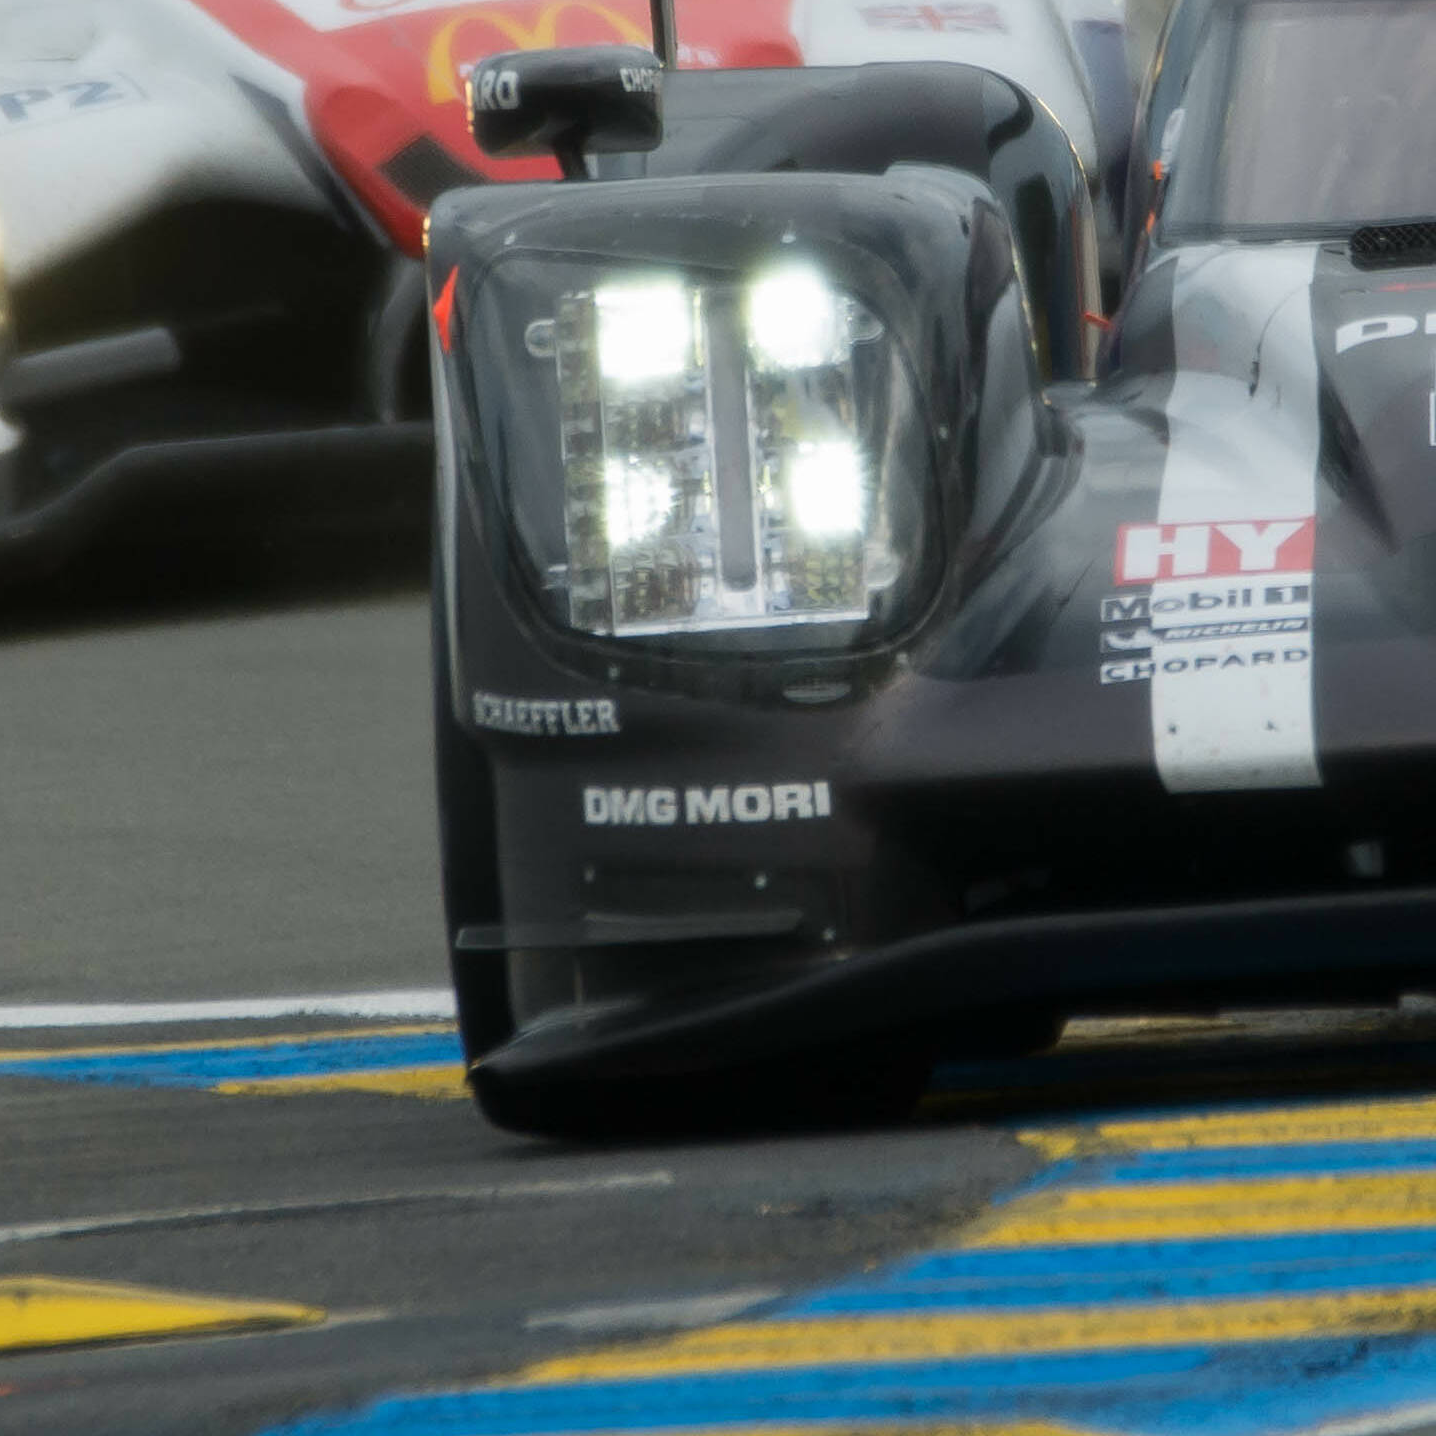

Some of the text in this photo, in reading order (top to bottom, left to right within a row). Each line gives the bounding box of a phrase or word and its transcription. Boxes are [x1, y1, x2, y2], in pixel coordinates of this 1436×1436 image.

[1122, 520, 1308, 582] HY
[1104, 587, 1253, 621] Mobil
[1165, 618, 1308, 642] MICHELIN
[1105, 648, 1310, 682] CHOPARD
[583, 780, 832, 825] DMG MORI
